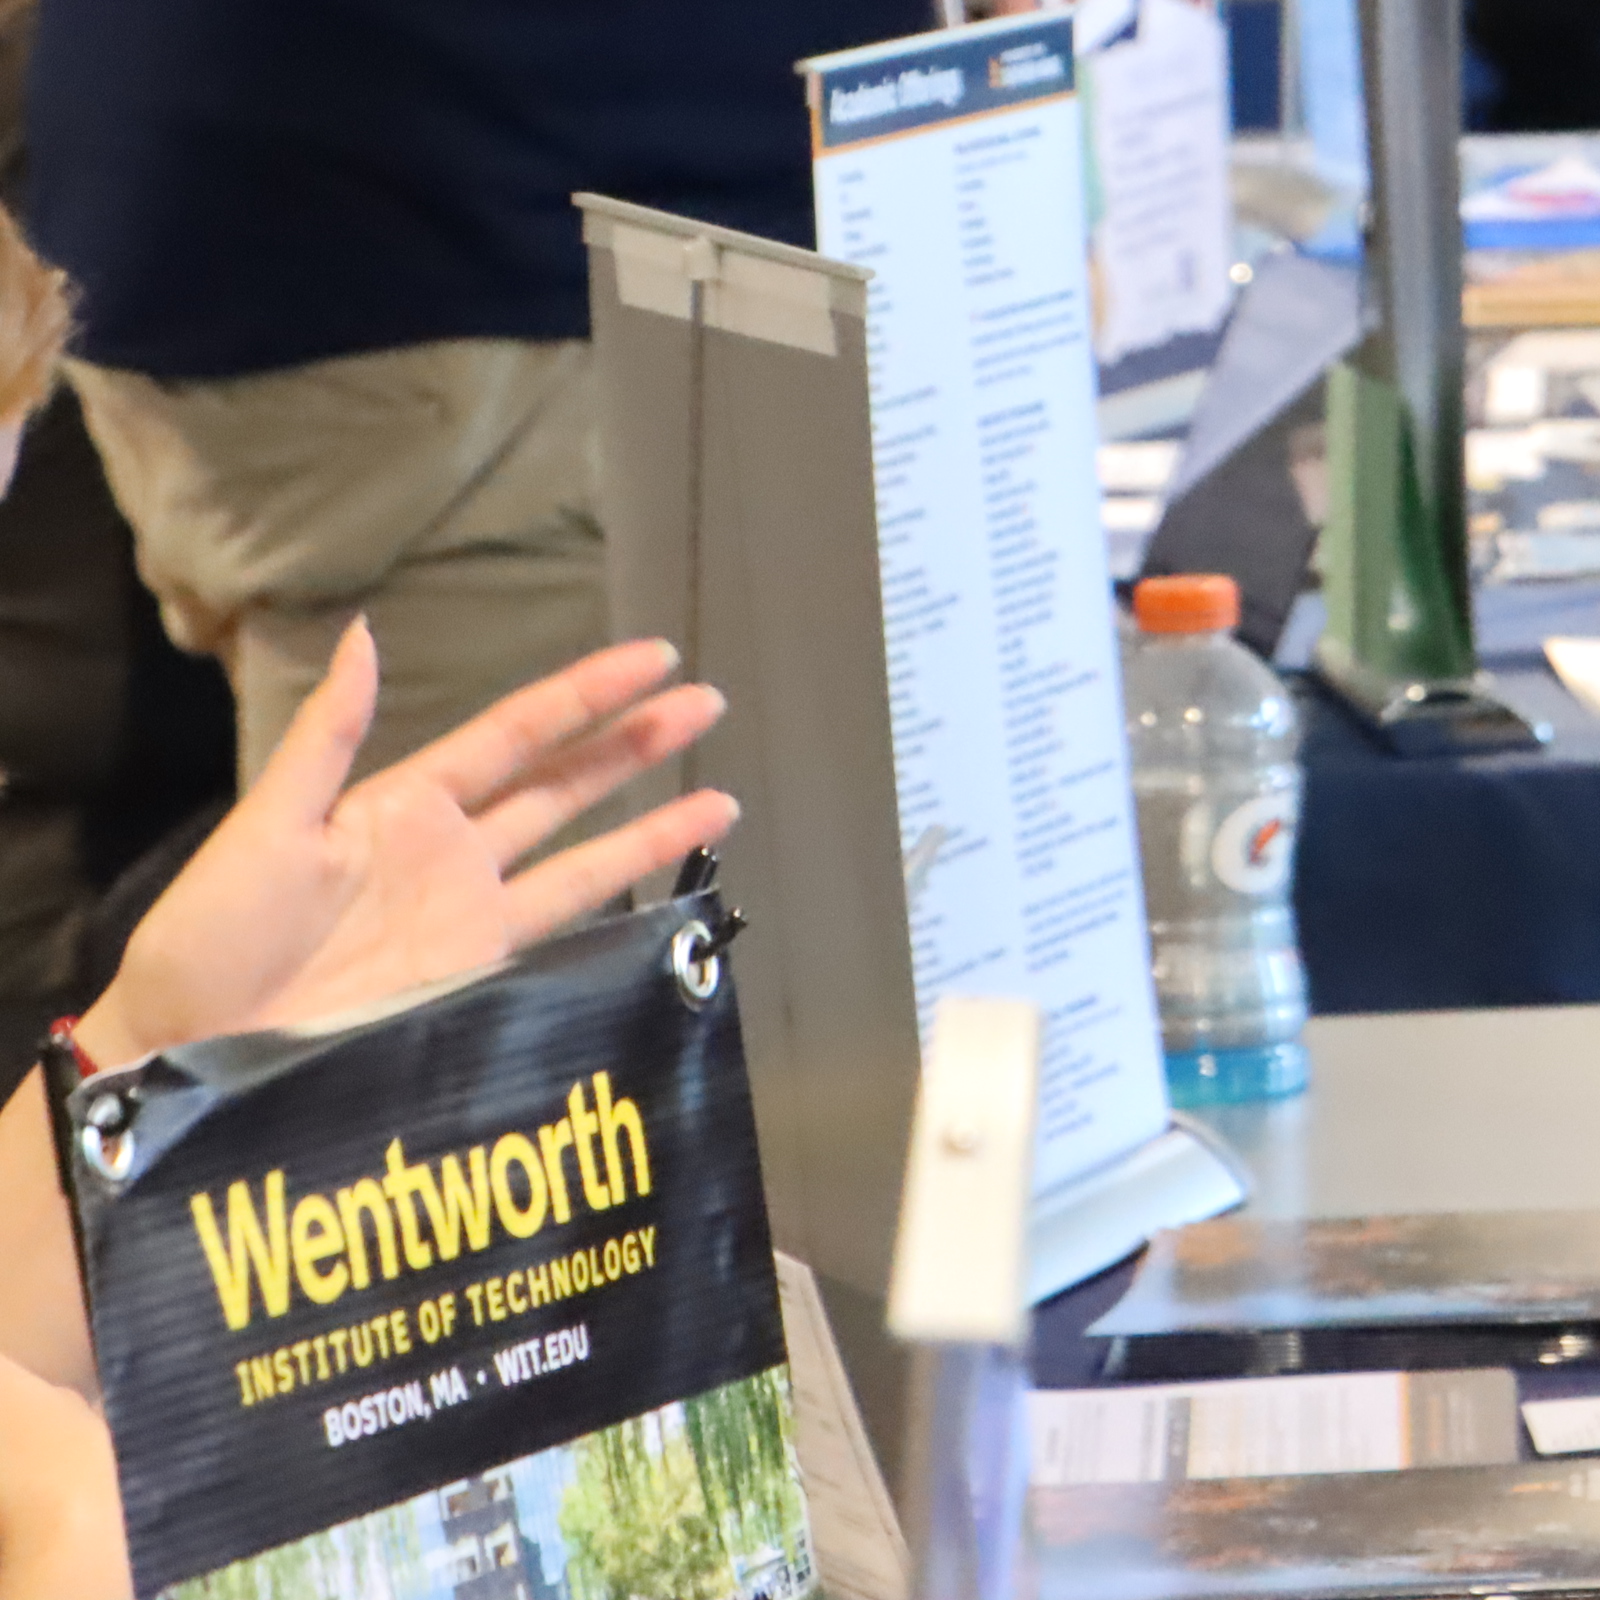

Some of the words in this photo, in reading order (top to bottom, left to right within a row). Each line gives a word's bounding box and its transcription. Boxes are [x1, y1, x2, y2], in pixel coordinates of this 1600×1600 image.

[190, 1069, 651, 1331] Wentworth
[234, 1310, 411, 1406] INSTITUTE
[418, 1293, 457, 1343] OF
[466, 1226, 657, 1325] TECHNOLOGY
[323, 1383, 432, 1447] BOSTON,
[430, 1366, 469, 1409] MA
[494, 1323, 590, 1387] WIT.EDU
